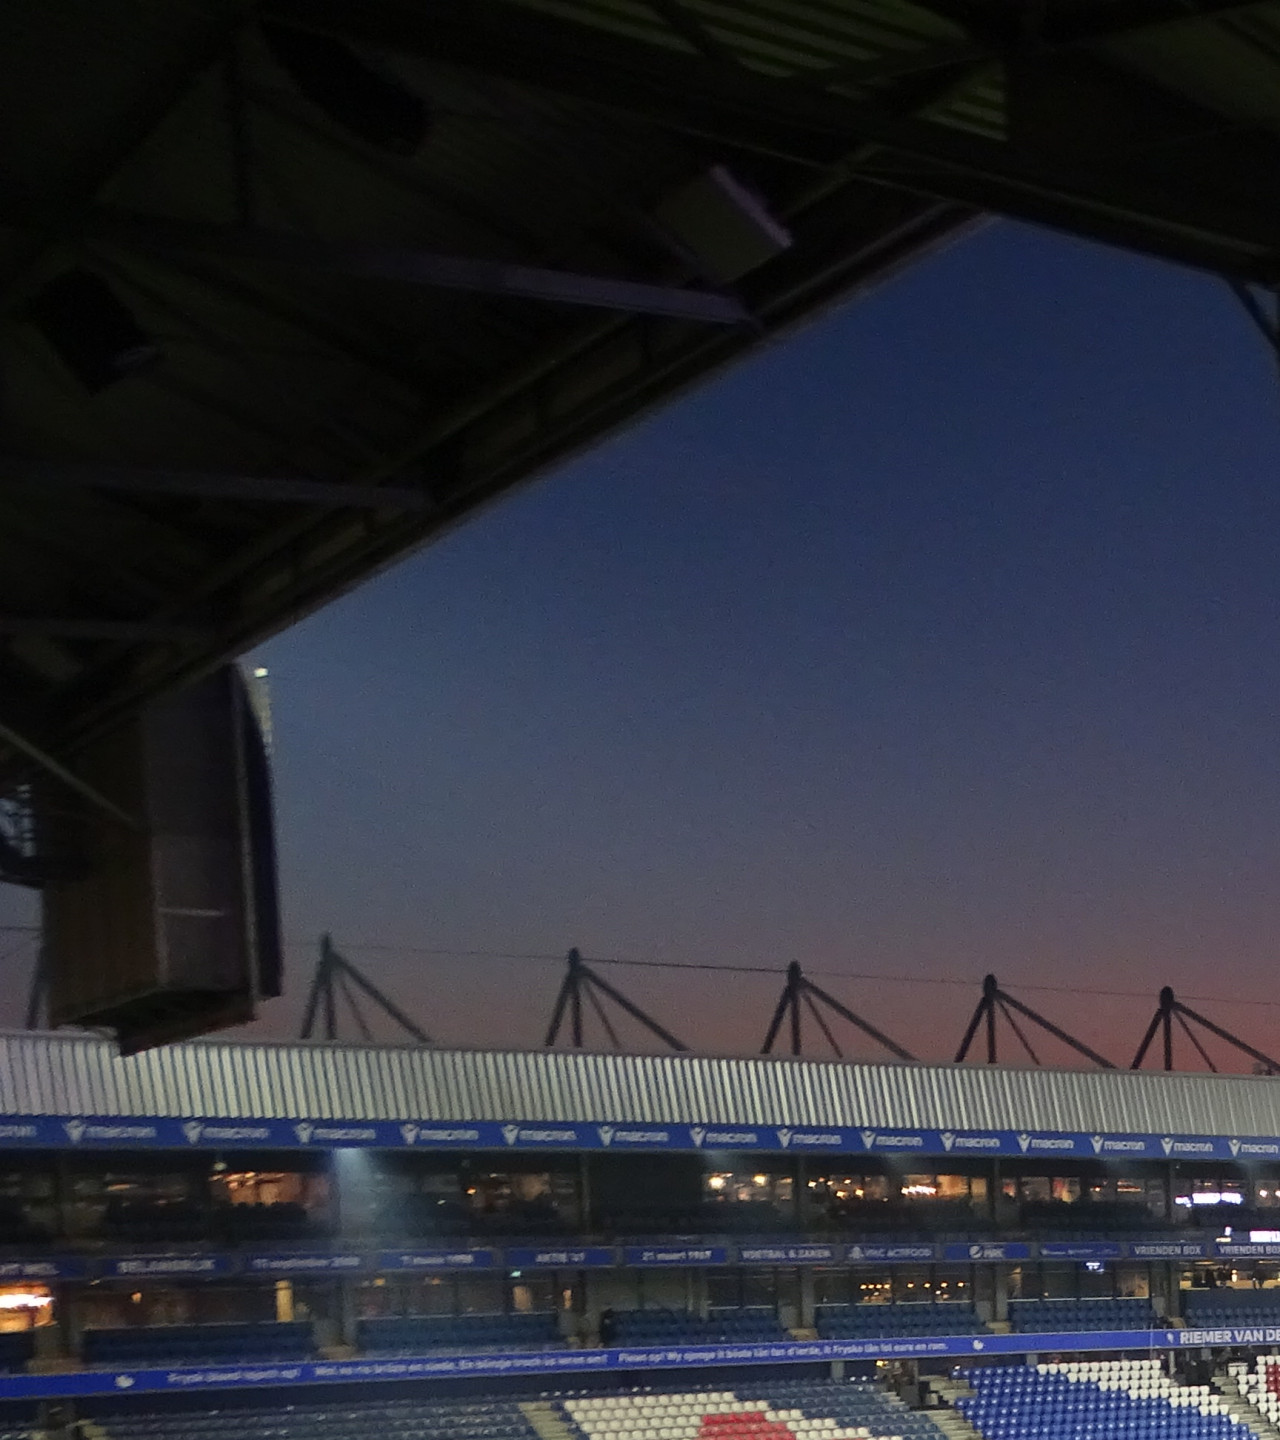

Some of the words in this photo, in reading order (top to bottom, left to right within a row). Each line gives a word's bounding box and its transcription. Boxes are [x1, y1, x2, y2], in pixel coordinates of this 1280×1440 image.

[955, 1137, 1000, 1148] macron
[1031, 1138, 1074, 1149] macron
[1104, 1140, 1145, 1151] macron
[1173, 1142, 1213, 1152] macron
[1241, 1143, 1279, 1154] macron
[1133, 1245, 1181, 1256] VRIENDEN
[1219, 1244, 1264, 1255] VRIENDEN
[1180, 1331, 1232, 1344] RIEMER
[1233, 1329, 1264, 1342] VAN
